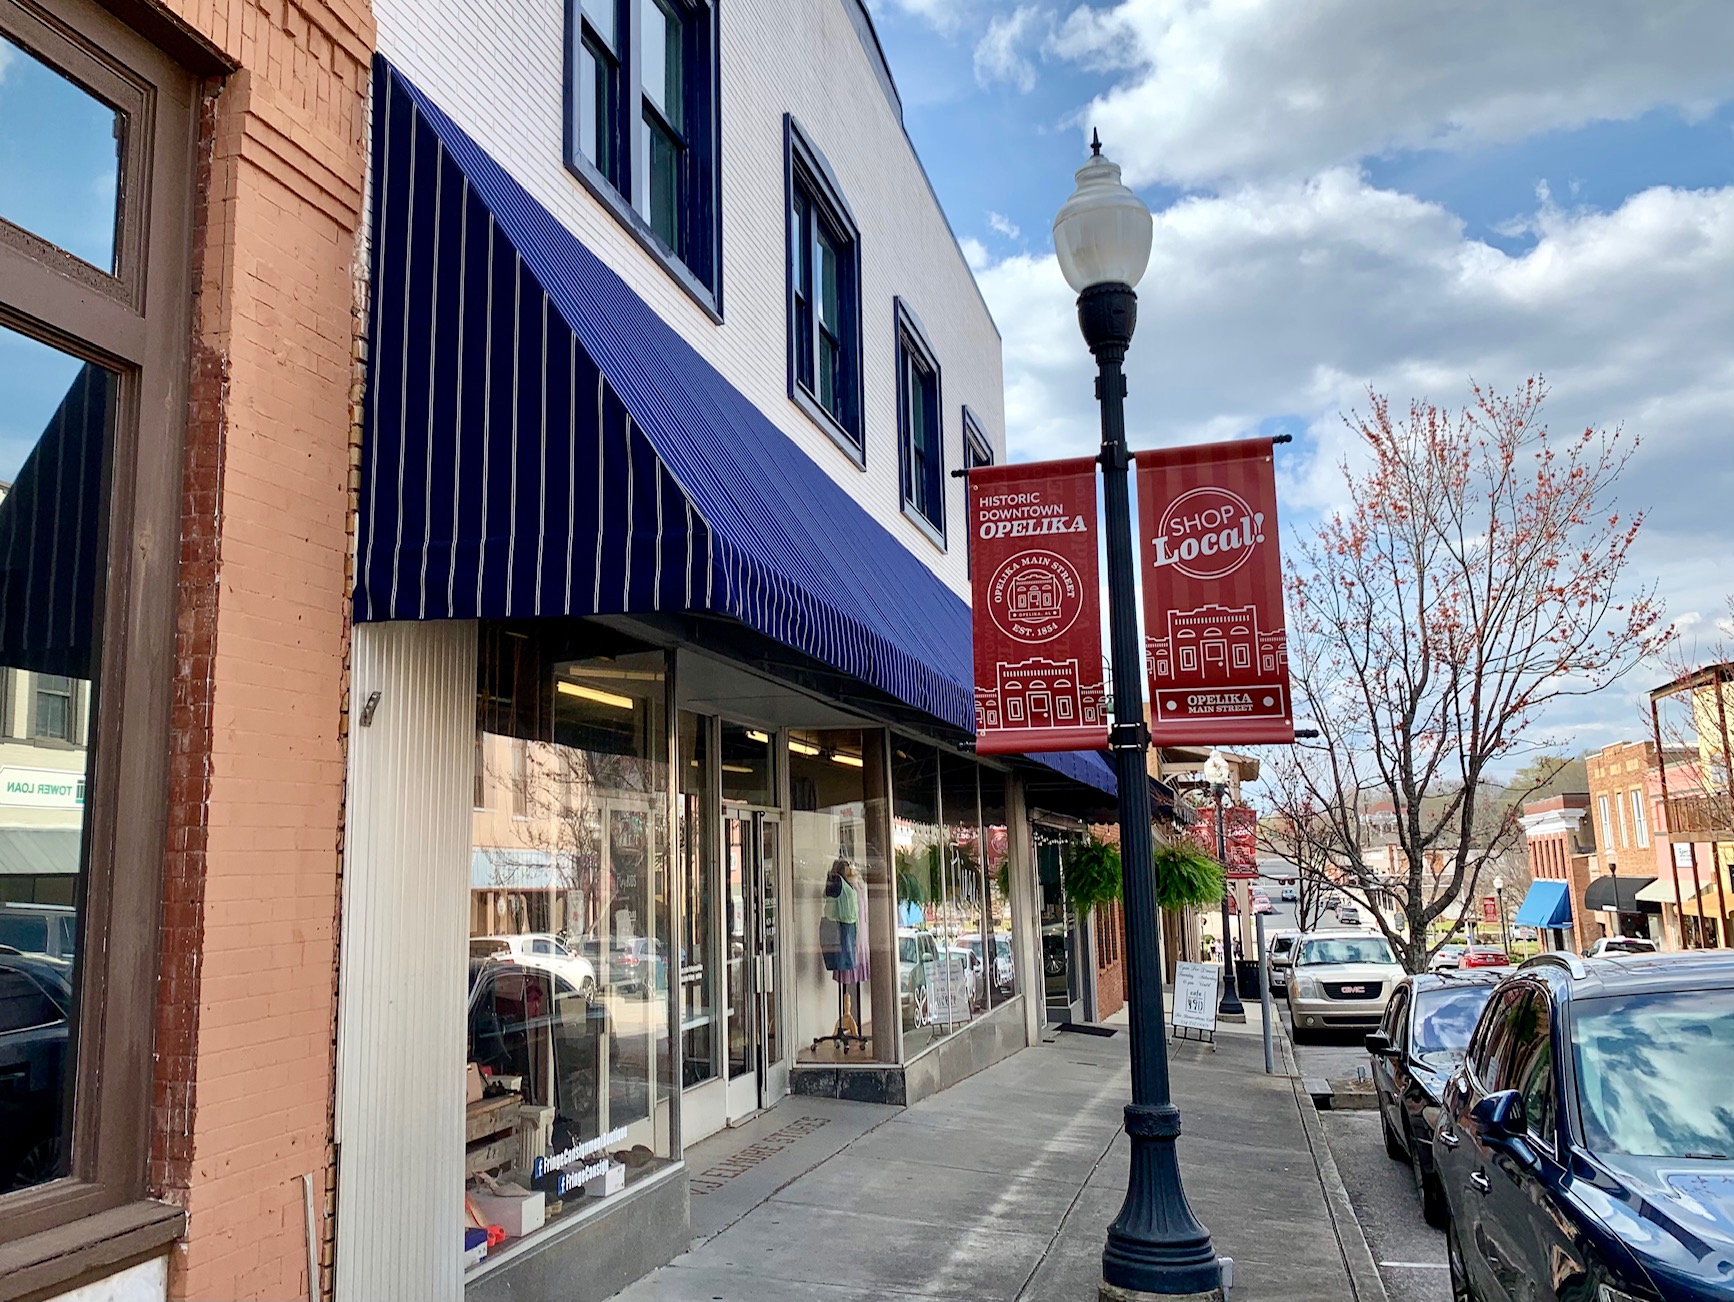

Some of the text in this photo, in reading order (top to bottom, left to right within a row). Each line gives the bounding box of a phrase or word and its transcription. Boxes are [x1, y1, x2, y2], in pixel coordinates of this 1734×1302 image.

[980, 492, 1040, 507] HISTORIC
[980, 504, 1063, 521] DOWNTOWN
[1170, 505, 1234, 536] SHOP
[980, 515, 1087, 540] OPELIKA
[1152, 512, 1265, 567] Local!
[994, 556, 1075, 603] OPELIKA MAIN STREET
[1012, 622, 1058, 637] EST. 1854
[1187, 693, 1253, 706] OPELIKA
[1188, 704, 1253, 714] MAIN STREET
[1341, 986, 1366, 994] GMC
[566, 1159, 610, 1191] FringeConsign
